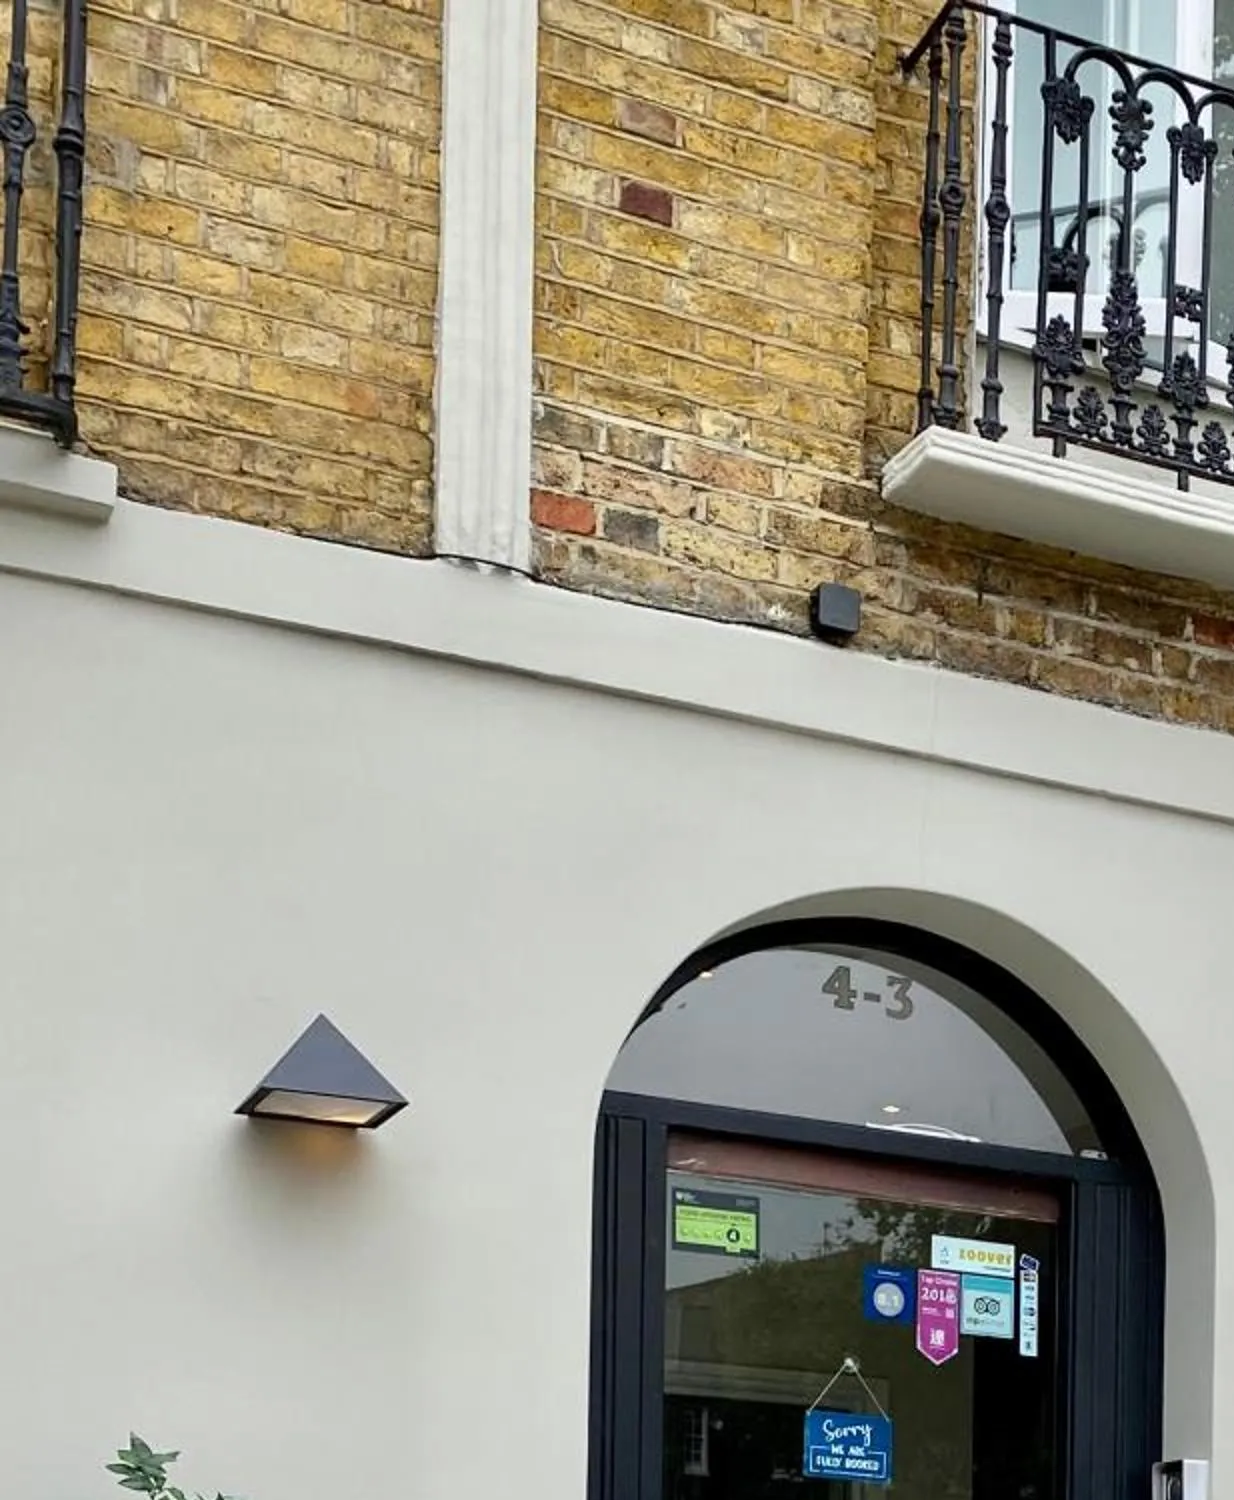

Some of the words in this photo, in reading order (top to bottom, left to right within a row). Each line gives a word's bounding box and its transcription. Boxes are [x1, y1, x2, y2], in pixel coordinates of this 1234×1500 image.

[822, 964, 914, 1021] 4-3
[822, 1418, 873, 1447] Sorry
[831, 1444, 845, 1455] WE
[815, 1455, 843, 1467] FULLY
[845, 1458, 880, 1471] BOOKED
